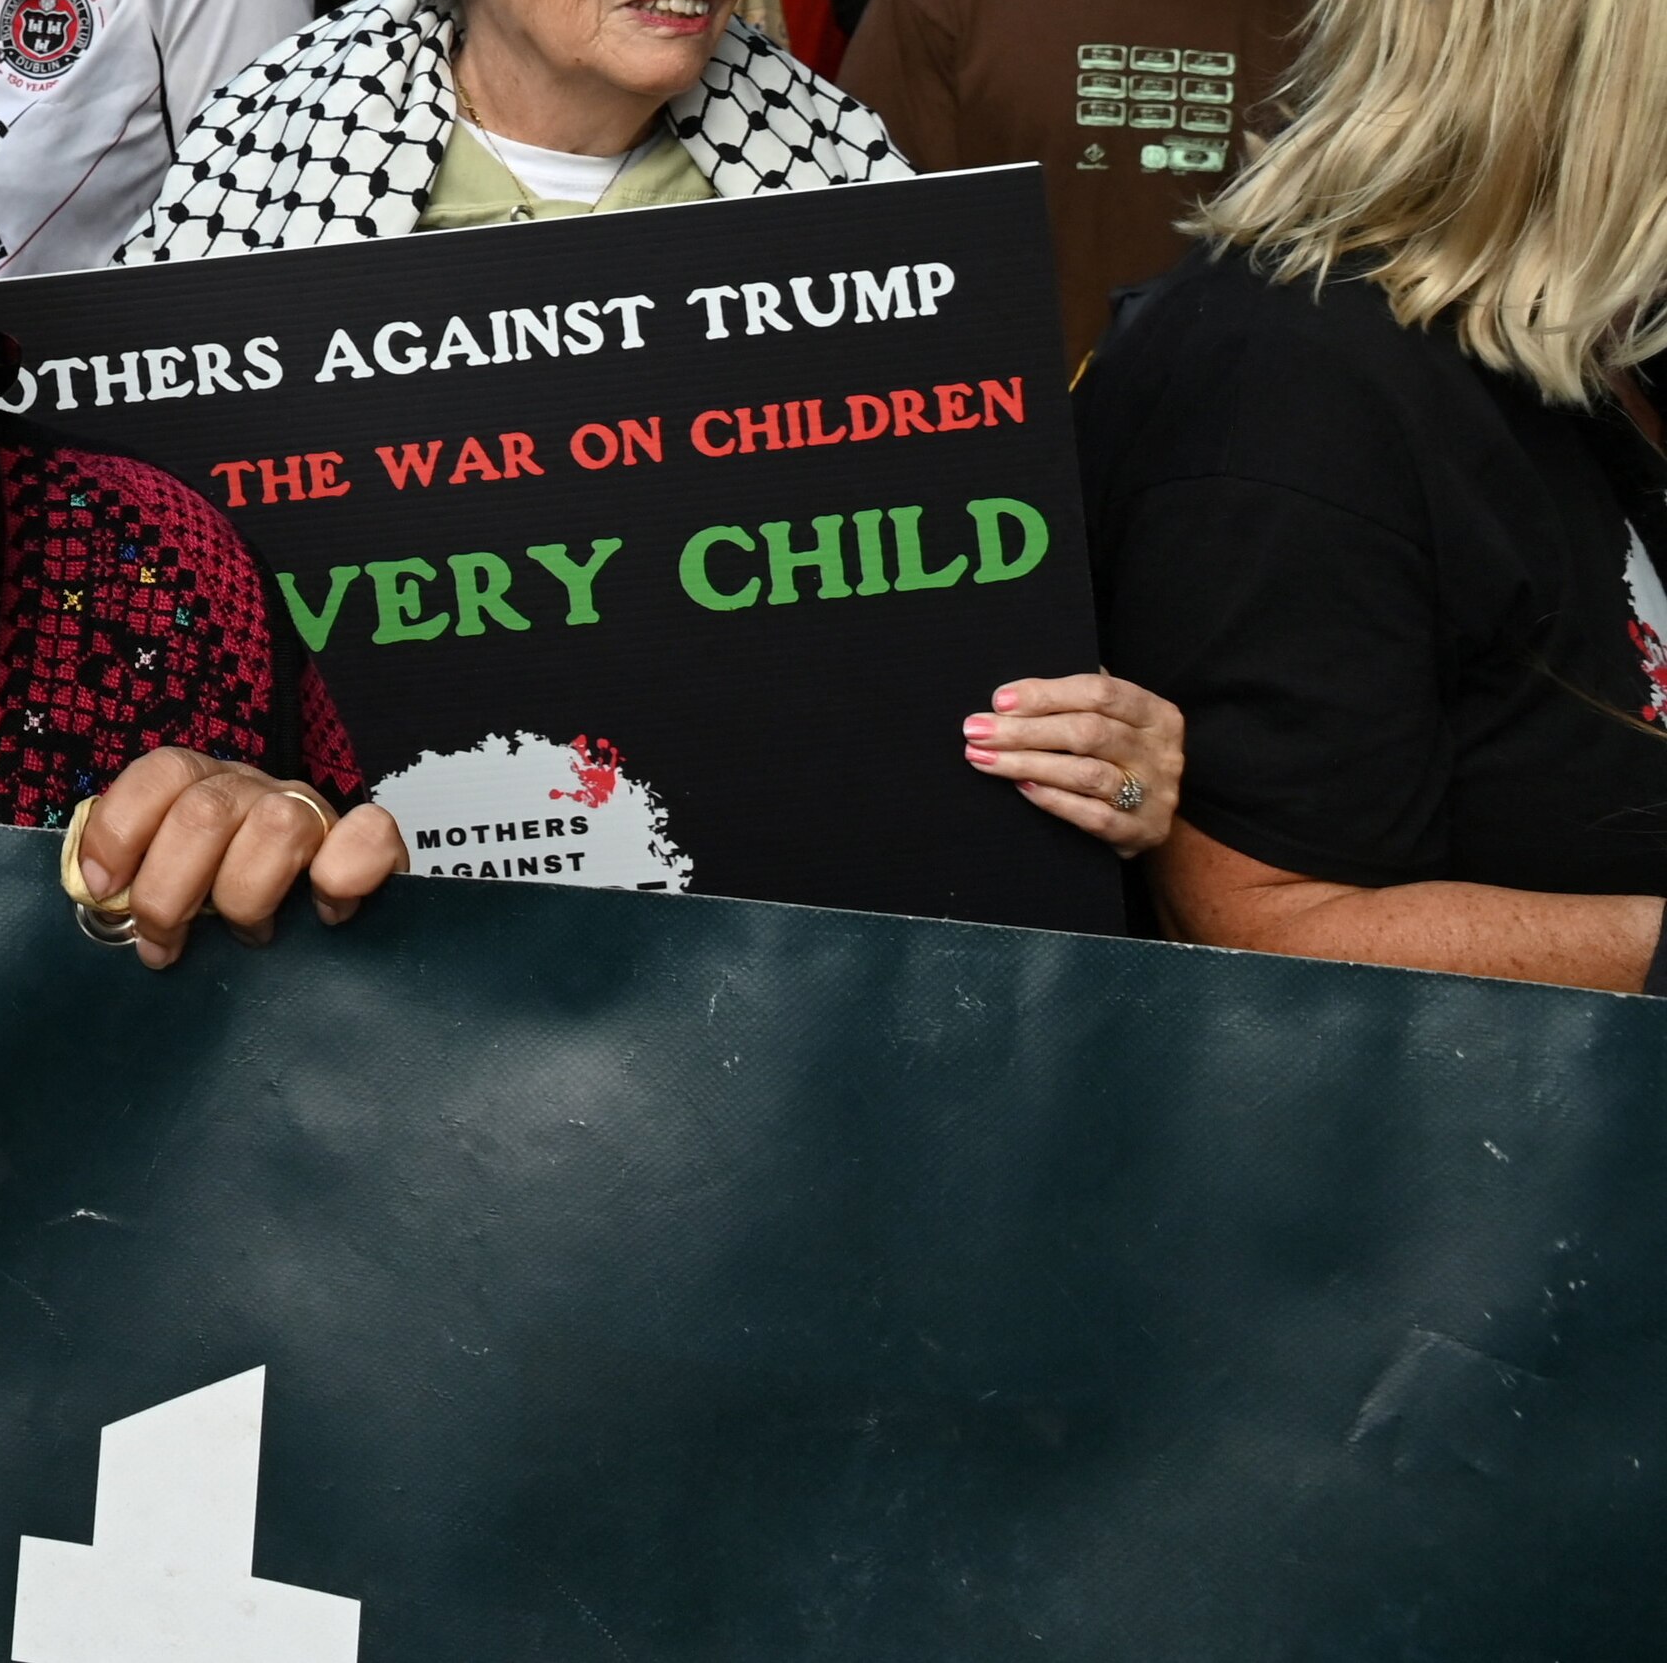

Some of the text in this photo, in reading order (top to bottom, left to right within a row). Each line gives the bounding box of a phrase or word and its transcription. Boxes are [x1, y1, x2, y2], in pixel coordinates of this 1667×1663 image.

[6, 73, 24, 88] 130
[15, 56, 61, 73] DUBLIN
[314, 293, 656, 383] AGAINST
[684, 260, 956, 342] TRUMP
[209, 376, 1026, 509] THE WAR ON CHILDREN
[677, 496, 1051, 614] CHILD
[416, 815, 589, 849] MOTHERS
